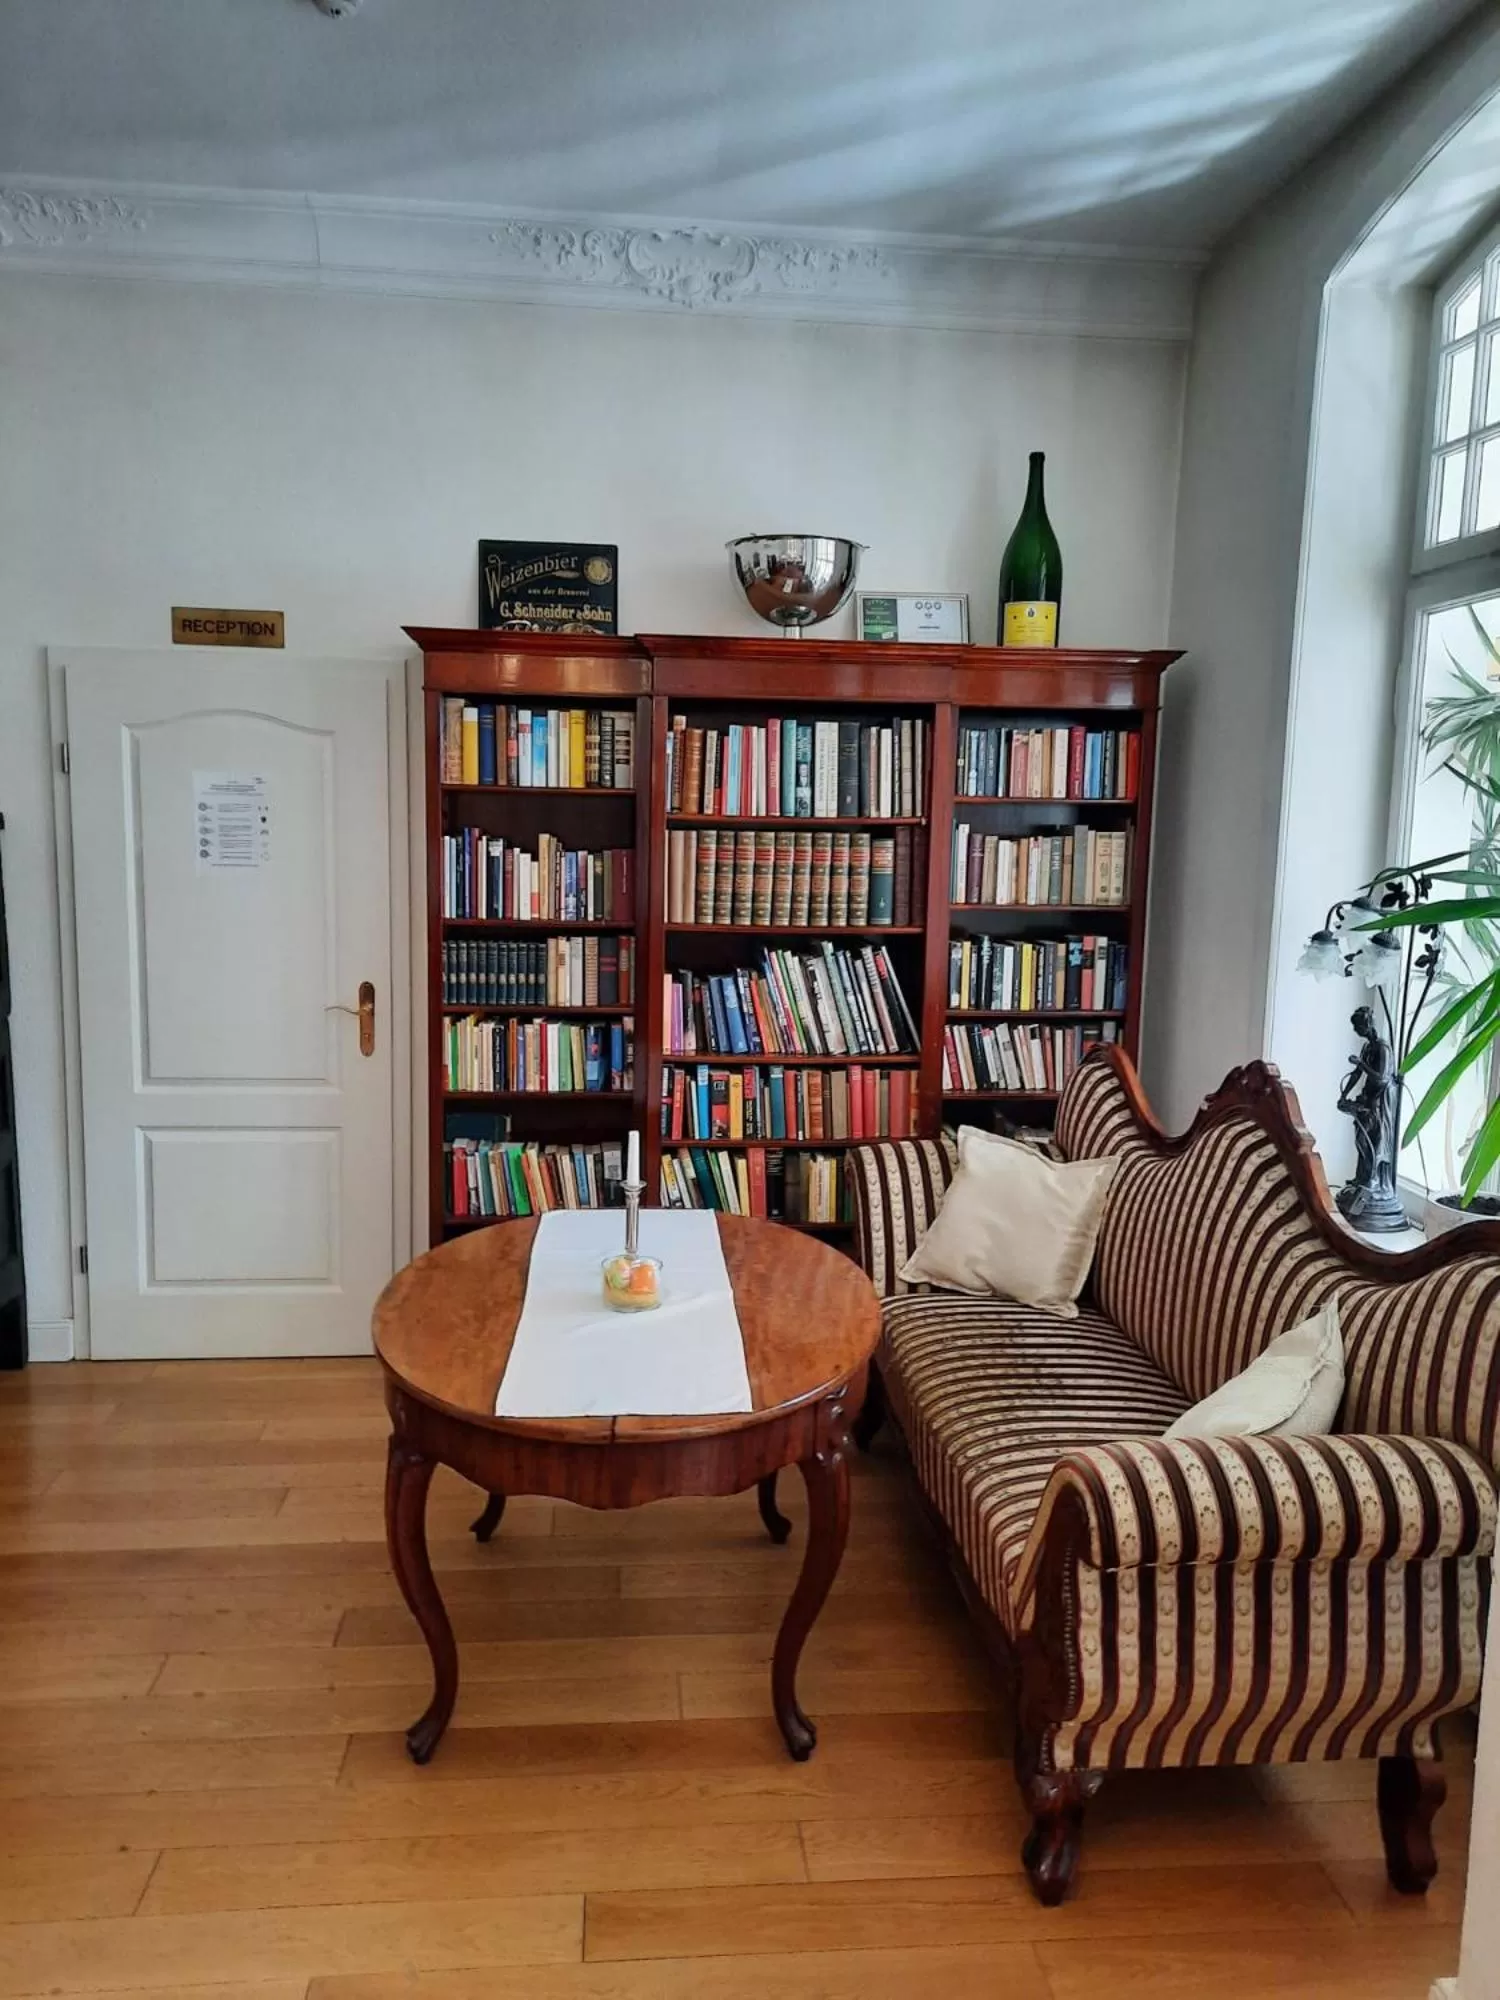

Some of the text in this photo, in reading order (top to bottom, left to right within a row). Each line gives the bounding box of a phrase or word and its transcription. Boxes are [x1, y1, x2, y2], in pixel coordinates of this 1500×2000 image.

[485, 554, 578, 609] Weizenbier
[514, 601, 575, 620] Schneider
[582, 604, 612, 622] Sohn
[182, 619, 275, 636] RECEPTION
